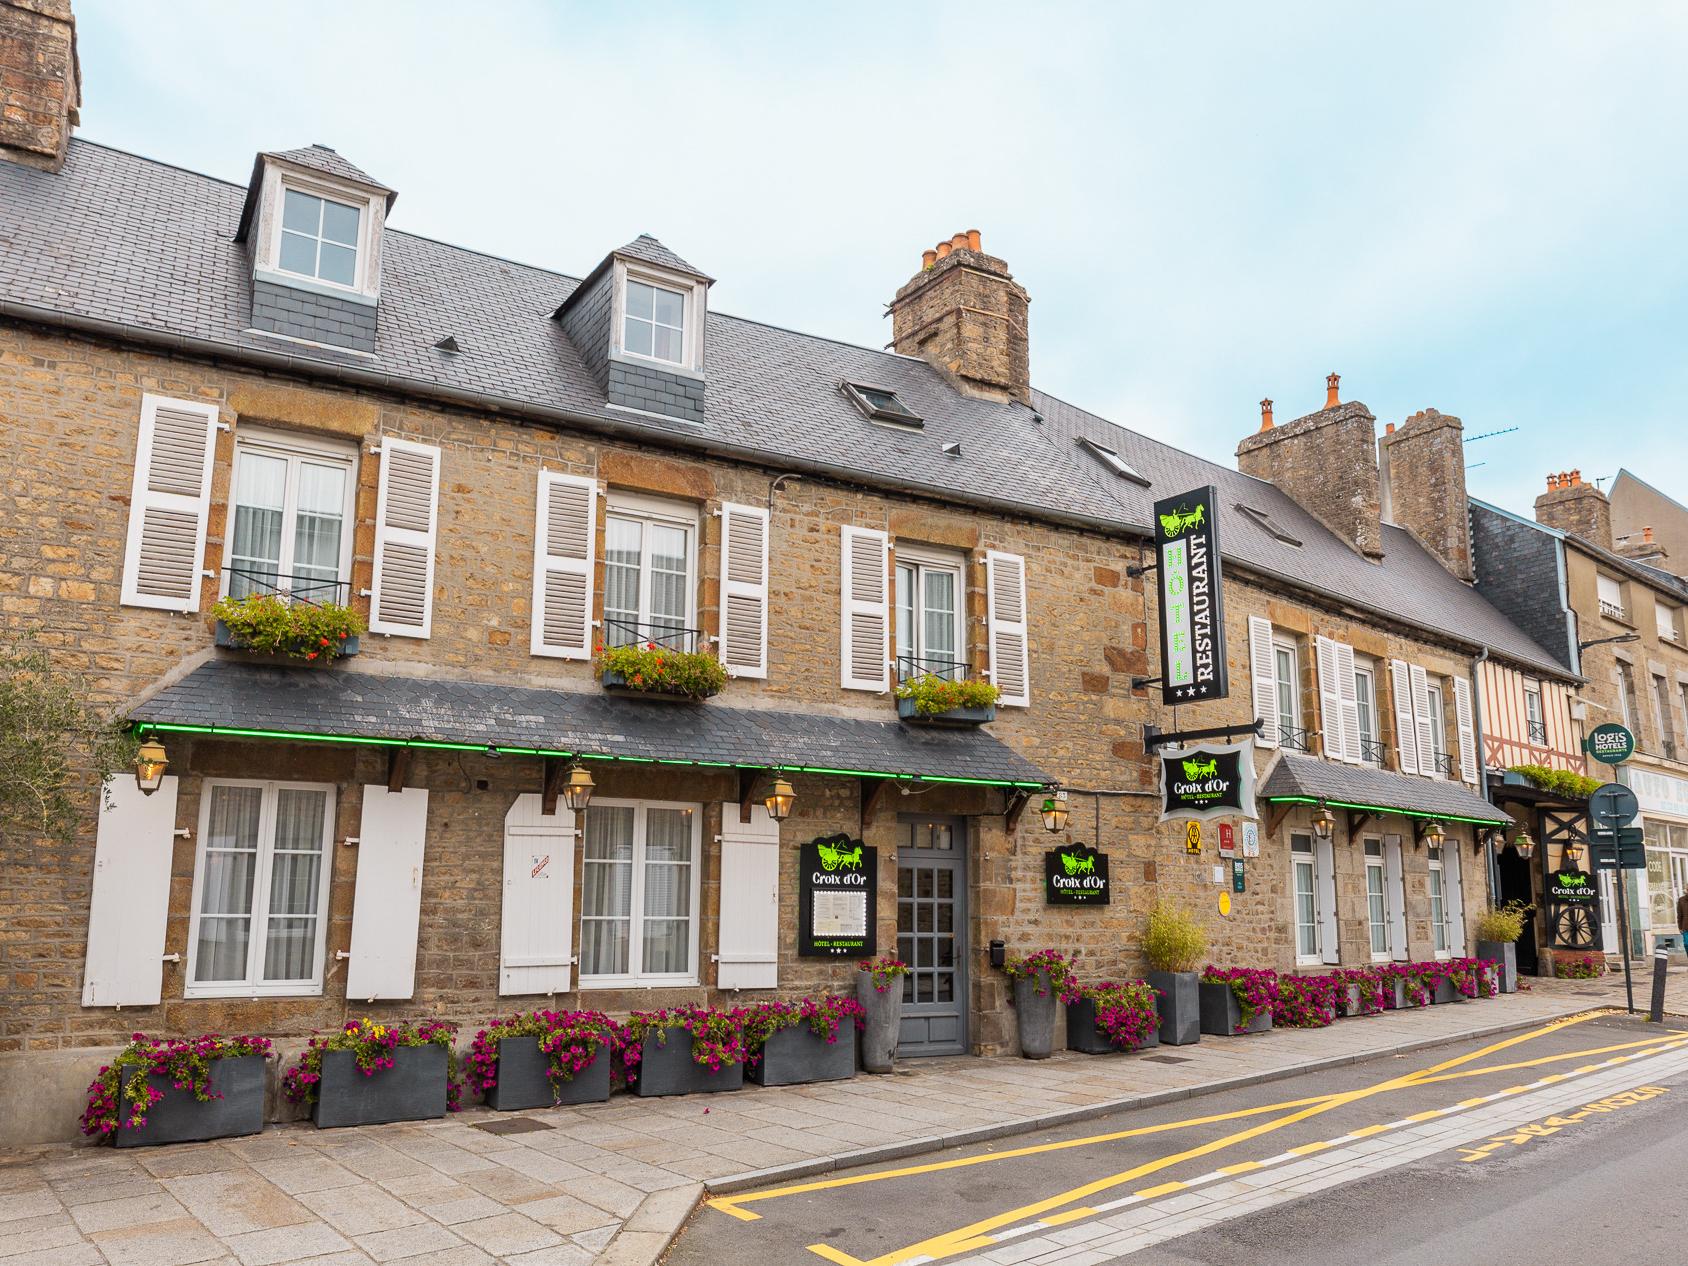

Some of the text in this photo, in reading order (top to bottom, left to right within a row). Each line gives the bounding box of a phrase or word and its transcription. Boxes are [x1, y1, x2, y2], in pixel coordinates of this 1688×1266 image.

[1190, 534, 1213, 683] RESTAURANT
[1594, 732, 1626, 743] Logis
[1595, 742, 1627, 751] HOTELS
[1174, 780, 1229, 794] Croix d'Or
[1648, 860, 1662, 872] CODE
[813, 872, 866, 885] Croix d'Or
[1053, 875, 1105, 888] Croix d'Or
[1552, 886, 1596, 896] Croix d'Or
[1456, 1084, 1671, 1162] LIVRAISONS
